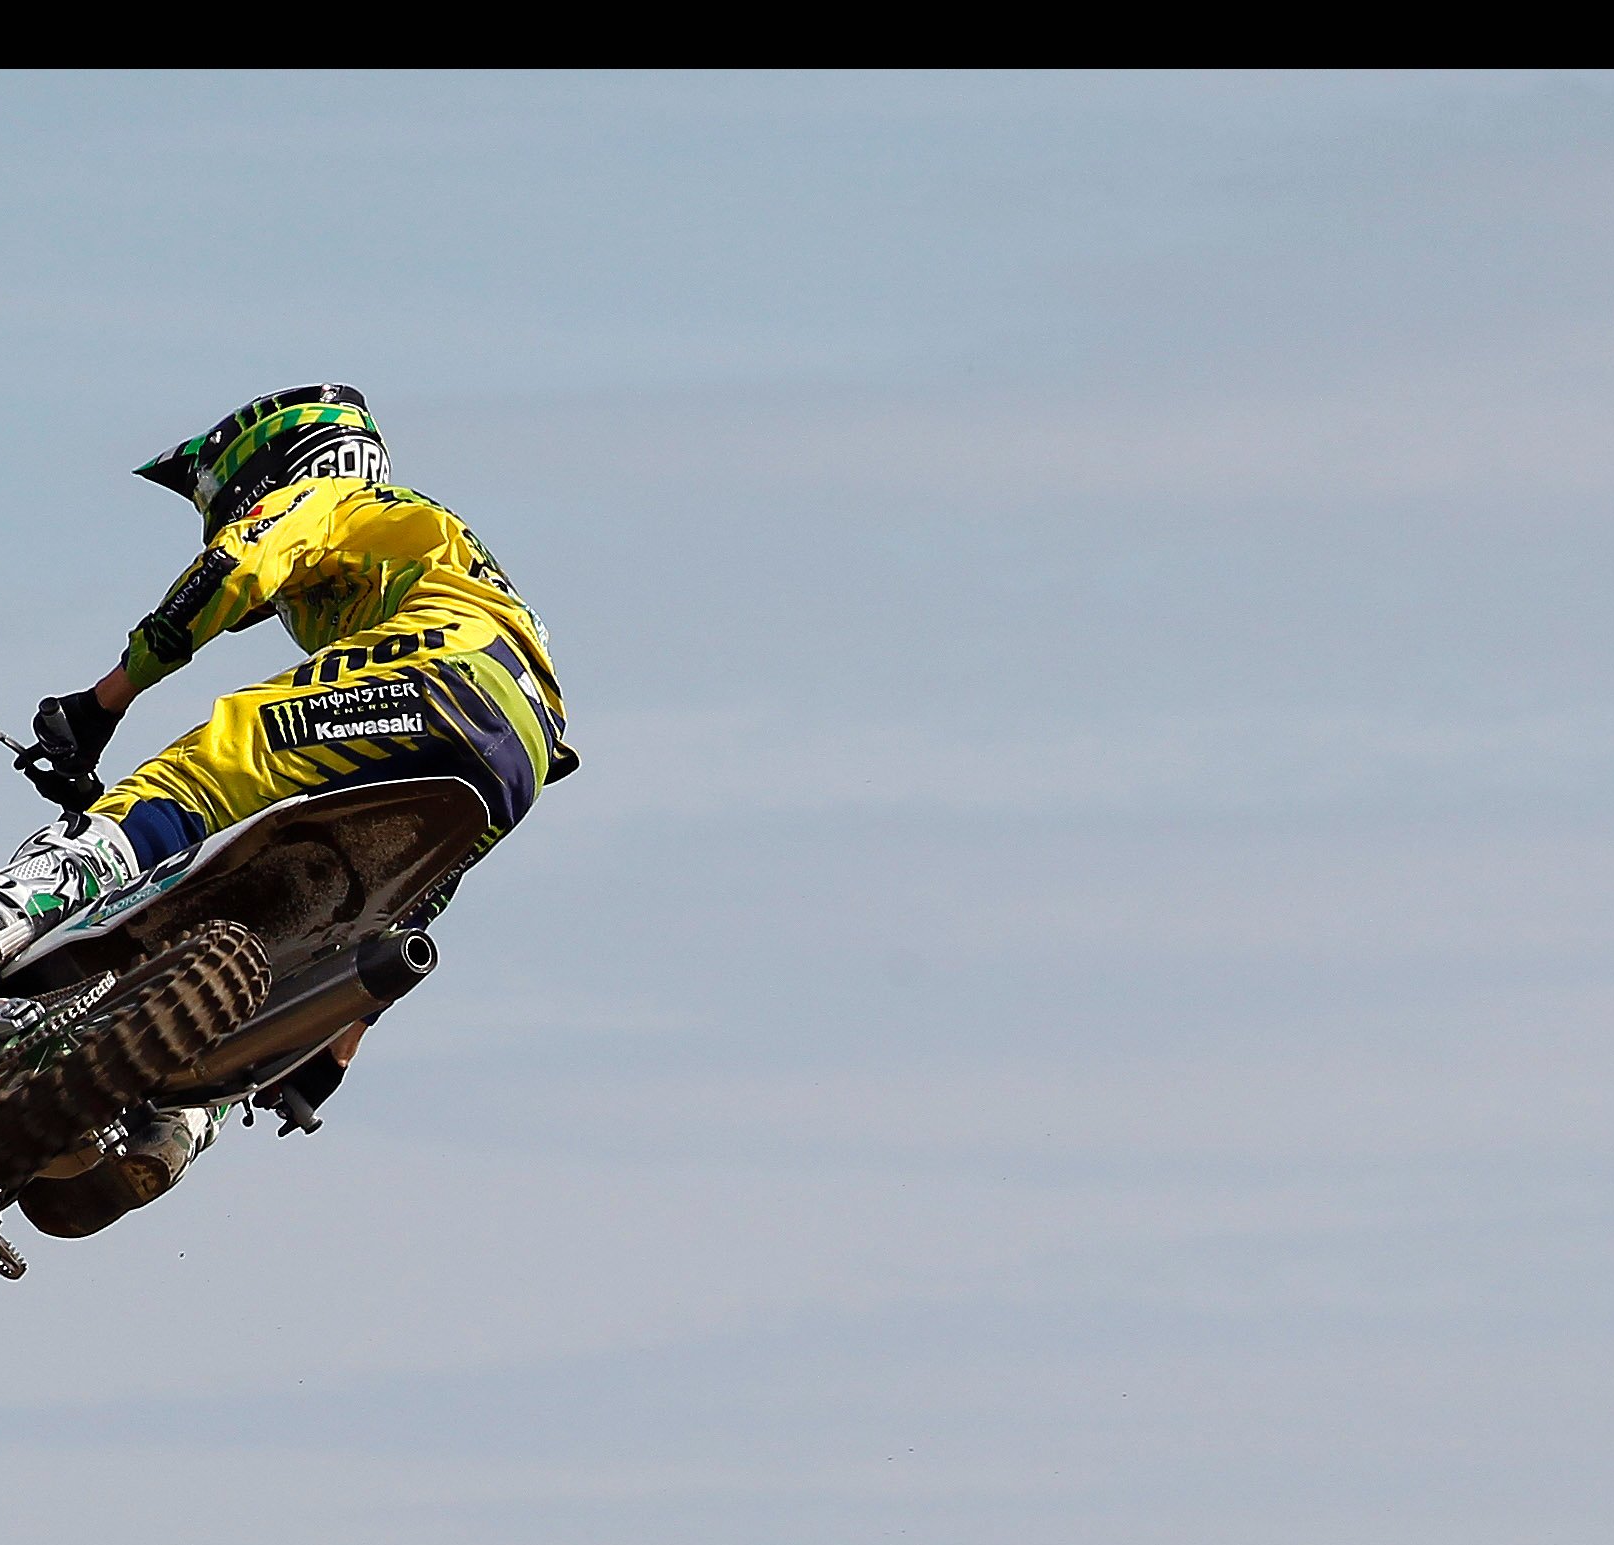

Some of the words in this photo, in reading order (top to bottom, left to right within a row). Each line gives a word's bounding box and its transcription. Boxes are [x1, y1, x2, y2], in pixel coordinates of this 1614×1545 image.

[309, 682, 420, 711] MONSTER
[333, 701, 400, 716] ENERGY
[314, 712, 424, 741] Kawasaki
